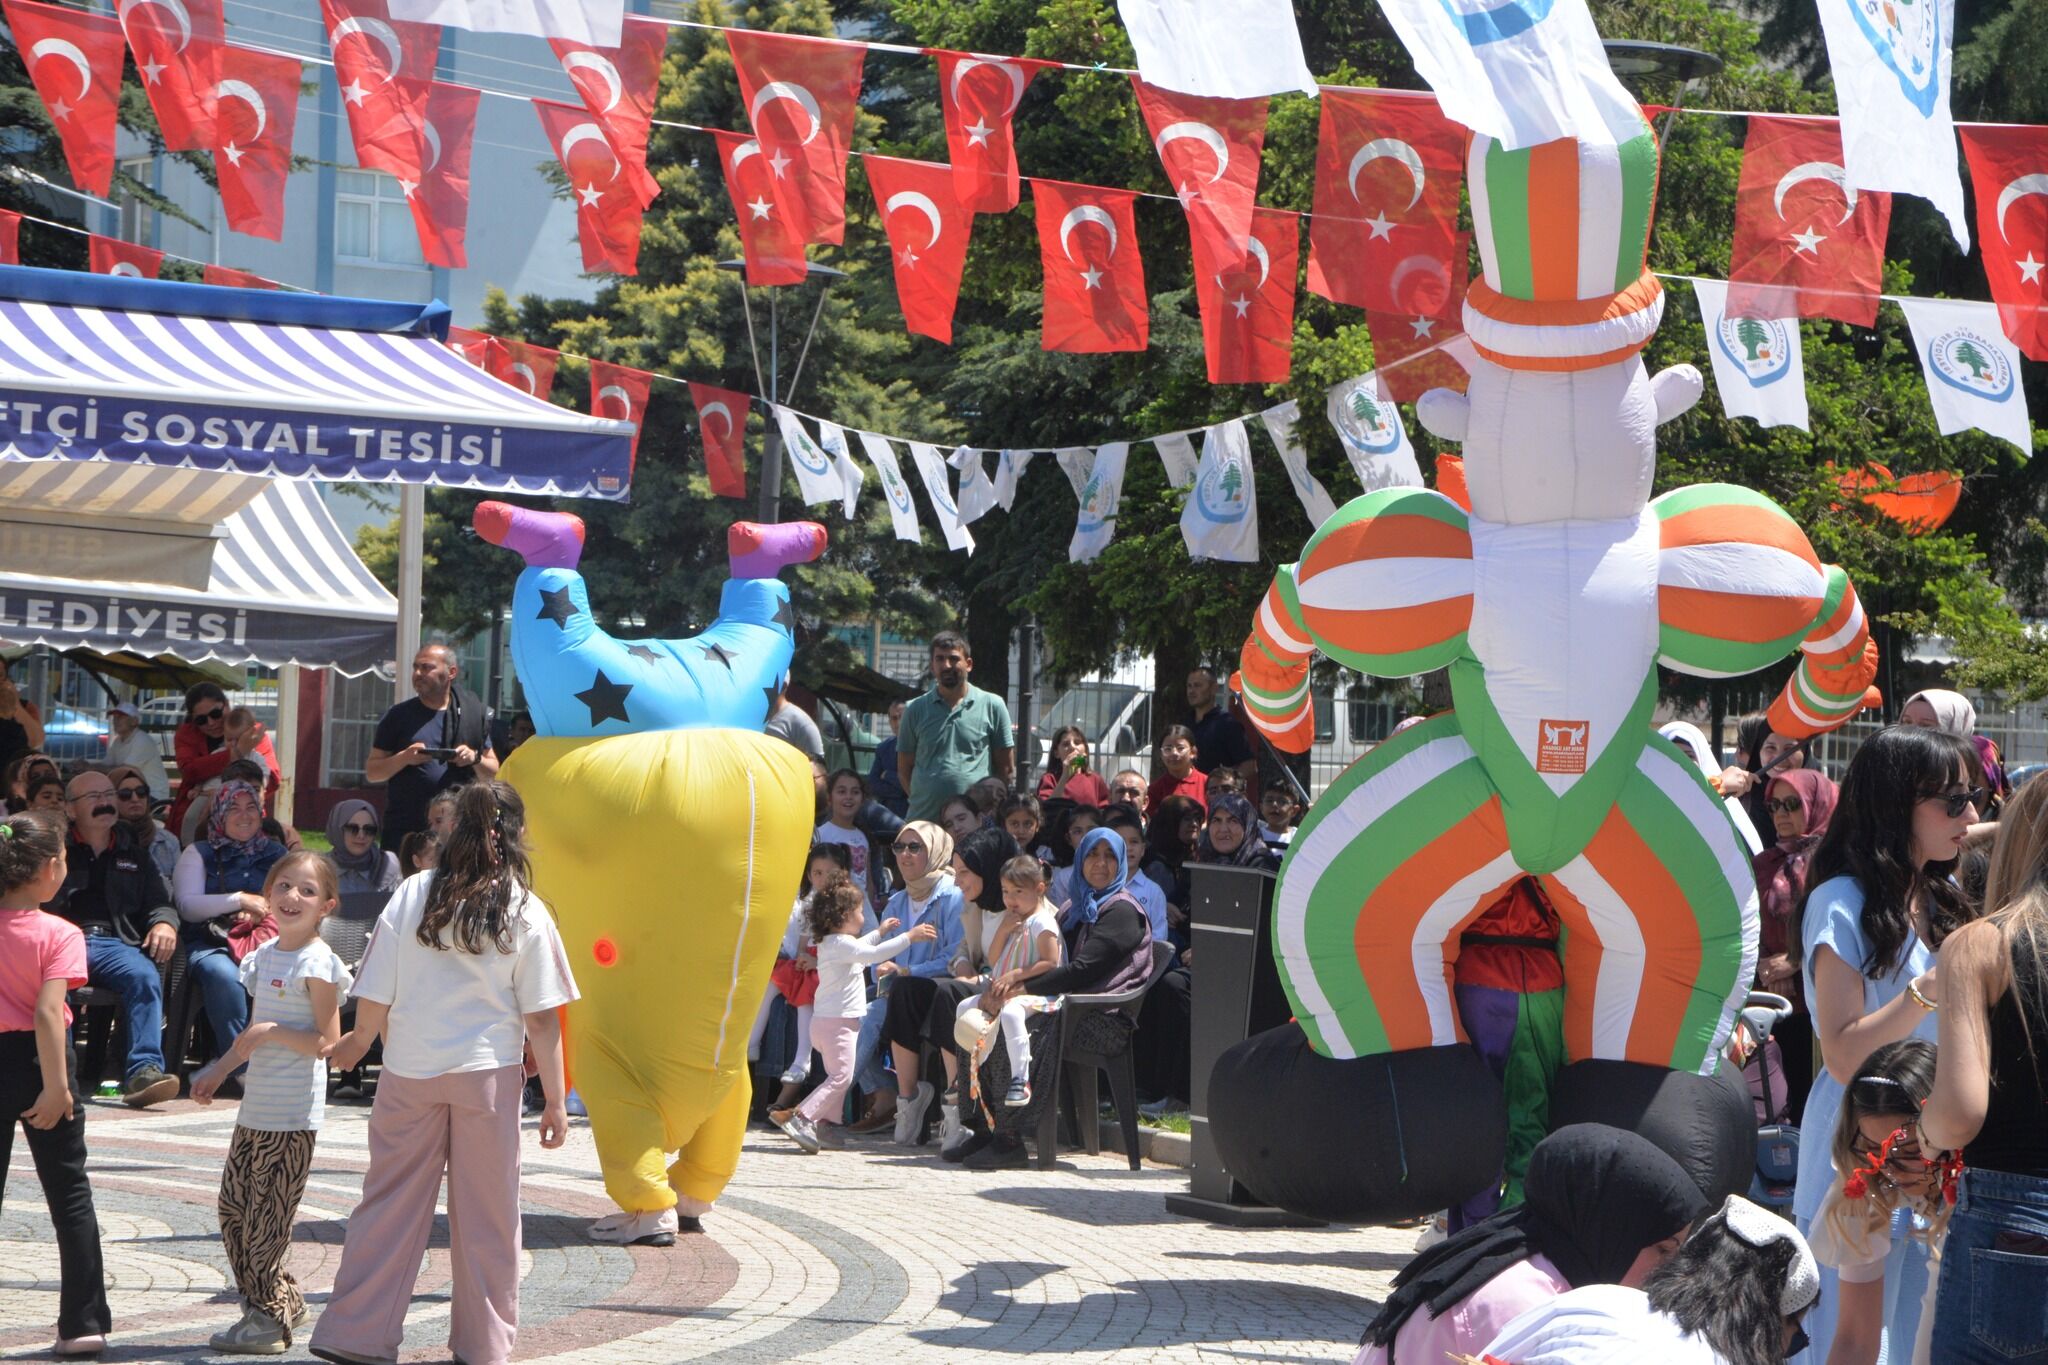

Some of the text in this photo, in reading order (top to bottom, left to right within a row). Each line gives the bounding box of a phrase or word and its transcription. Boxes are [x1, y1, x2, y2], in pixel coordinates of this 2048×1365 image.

[0, 398, 502, 467] TÇİ SOSYAL TESİSİ
[0, 596, 248, 646] LEDİYESİ
